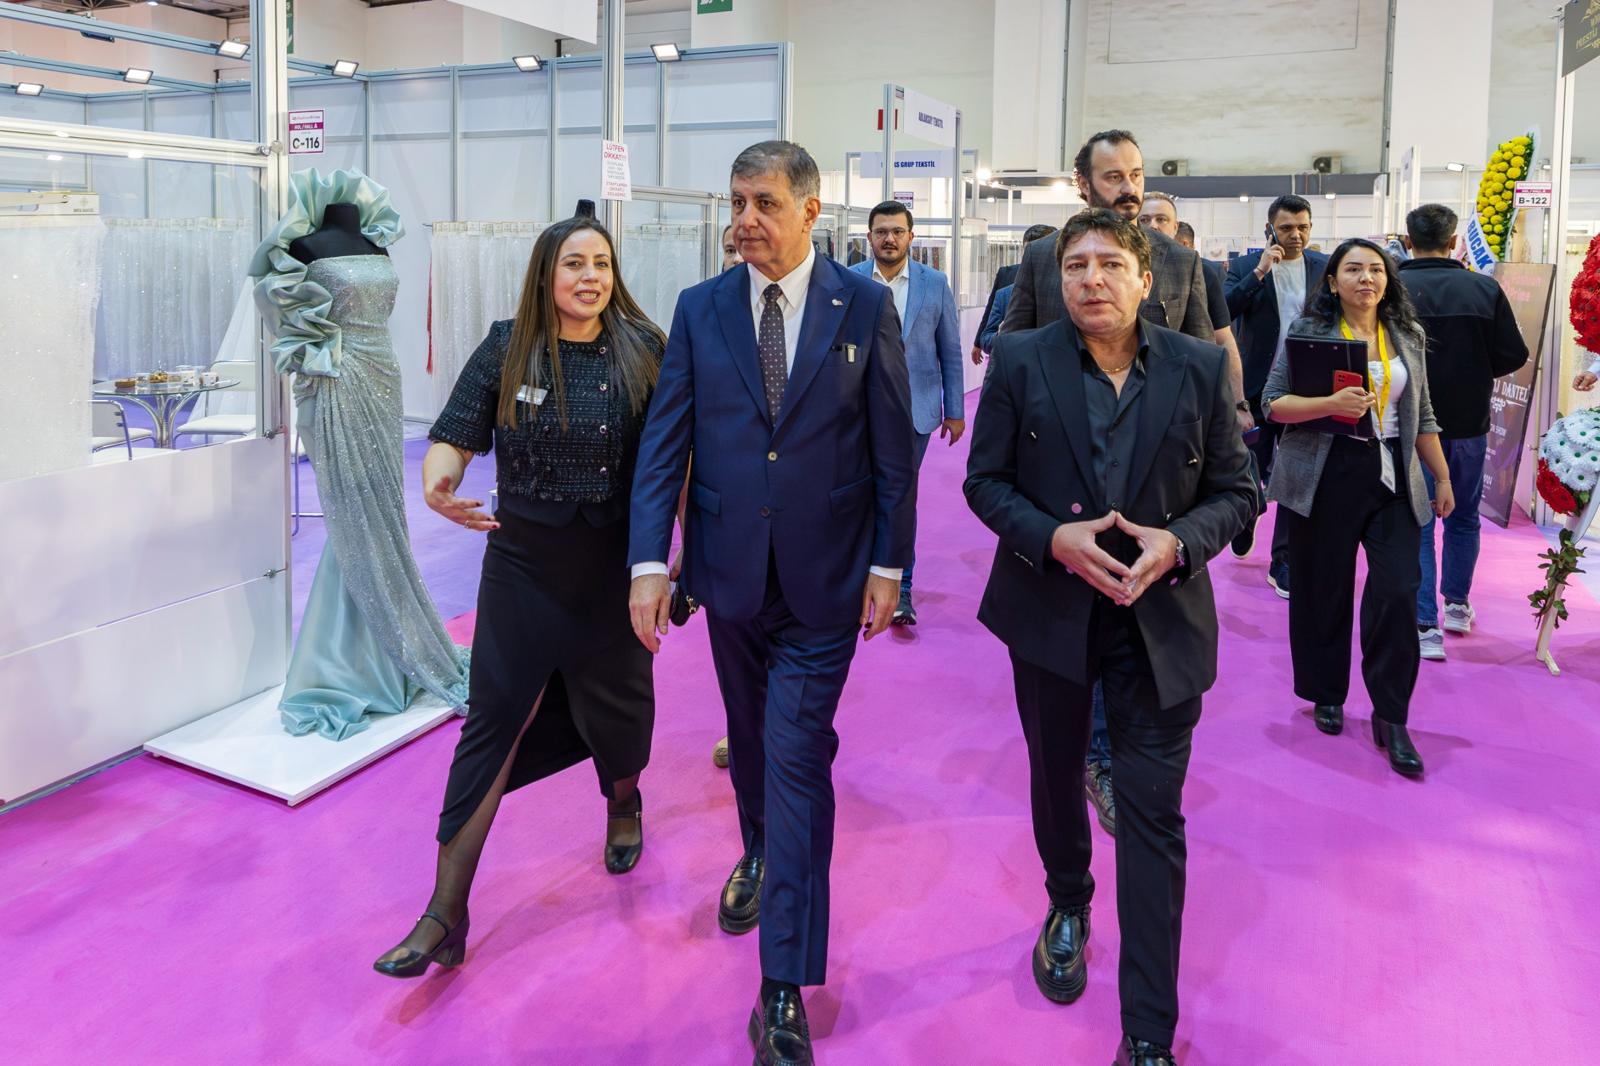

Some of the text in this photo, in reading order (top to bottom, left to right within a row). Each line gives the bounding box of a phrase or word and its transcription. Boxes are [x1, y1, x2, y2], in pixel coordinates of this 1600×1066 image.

[293, 137, 319, 149] C-116
[1518, 197, 1548, 205] B-122
[1468, 221, 1493, 270] BUCAK
[1501, 381, 1528, 403] DANTEL
